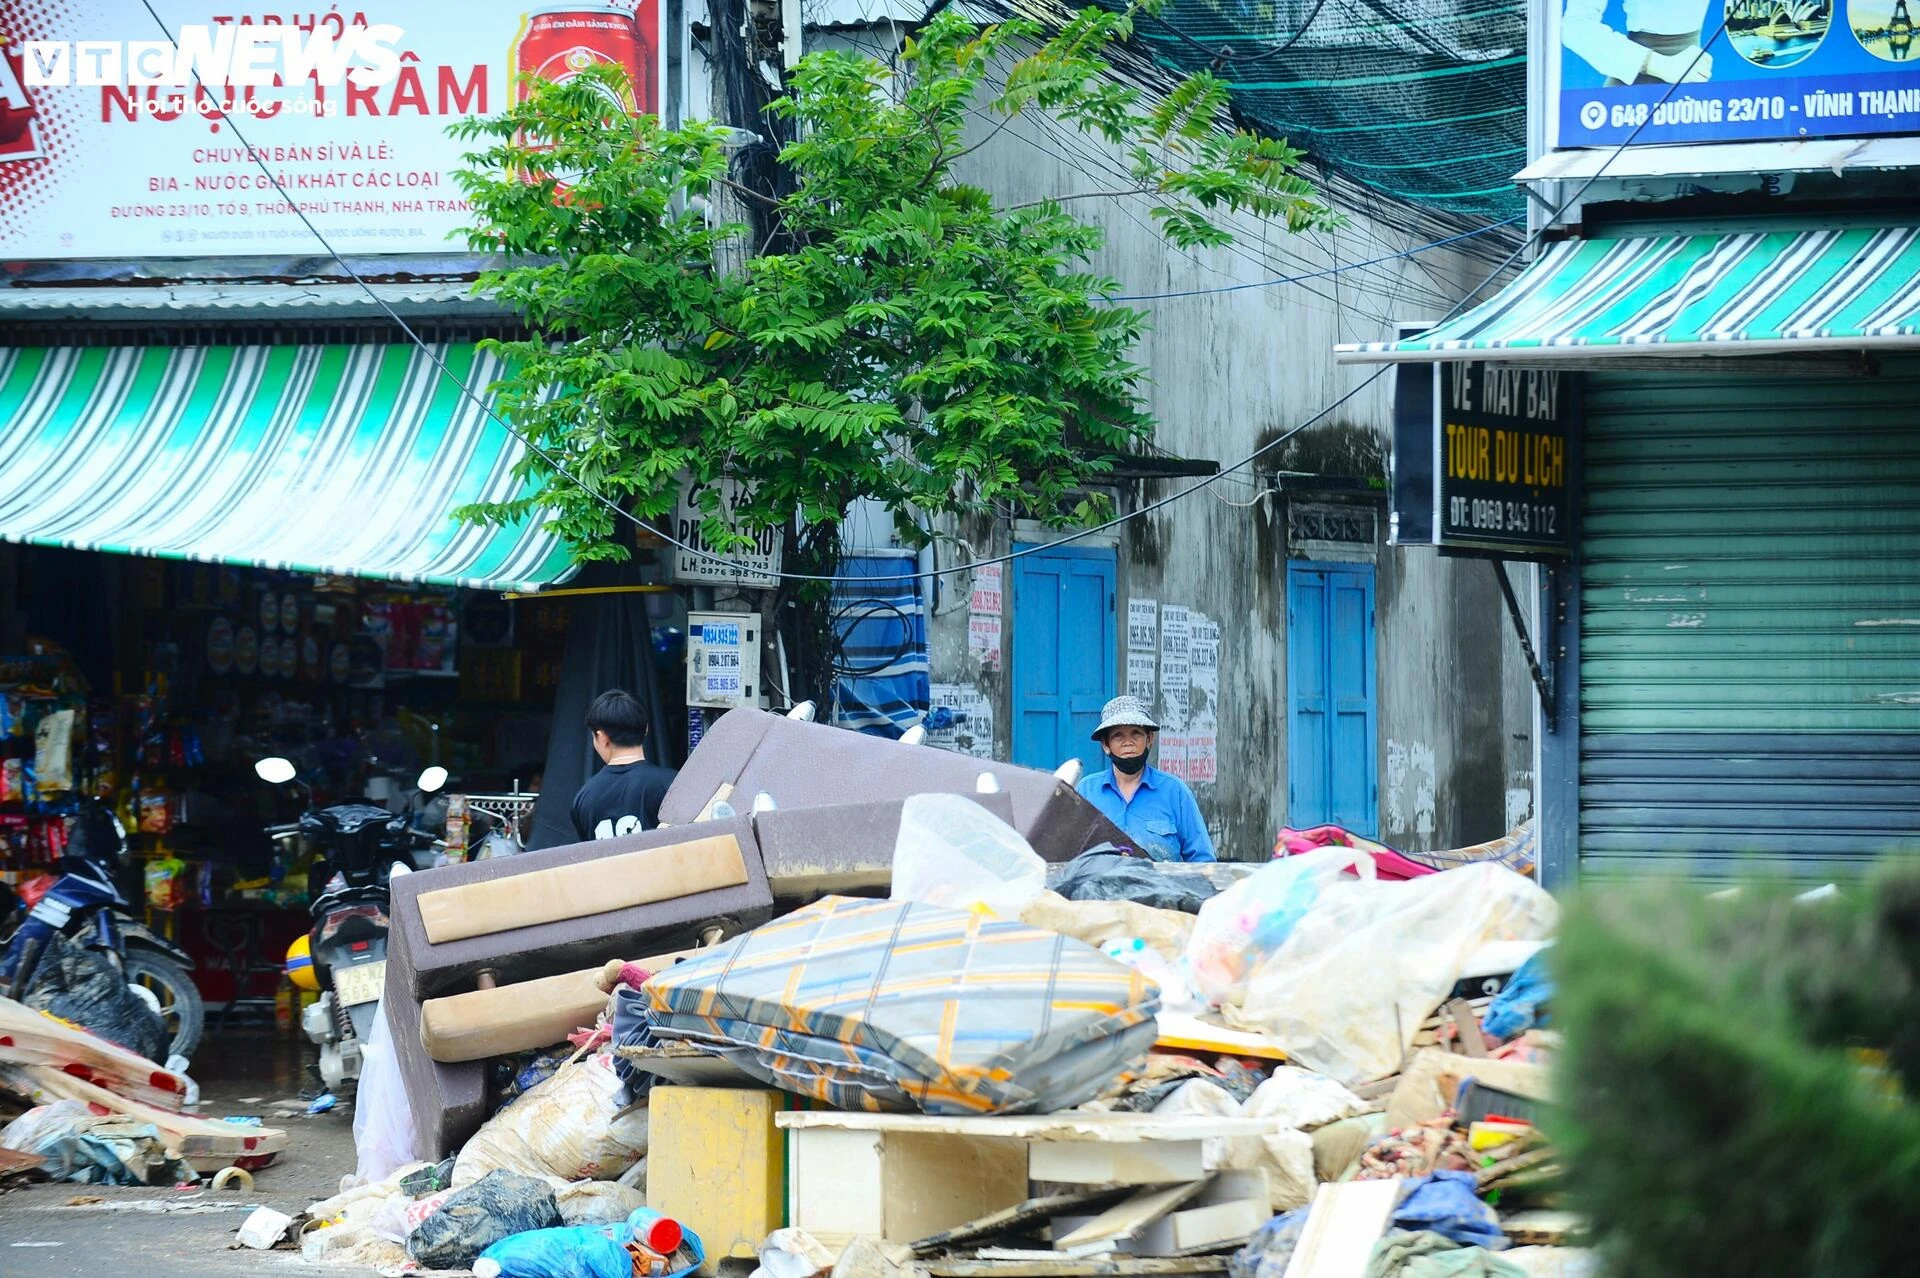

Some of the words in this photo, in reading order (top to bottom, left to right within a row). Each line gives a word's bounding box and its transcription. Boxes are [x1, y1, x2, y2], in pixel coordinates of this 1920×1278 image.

[1611, 103, 1649, 128] 648
[1653, 95, 1723, 126] ĐƯỜNG
[1727, 96, 1785, 122] 23/10
[1804, 89, 1853, 118] VĨNH
[193, 144, 270, 163] CHUYÊN
[275, 142, 313, 162] BÁN
[317, 141, 334, 161] SỈ
[338, 141, 363, 160] VÀ
[367, 139, 394, 160] LẺ:
[149, 177, 179, 192] BIA
[195, 171, 251, 191] NƯỚC
[256, 170, 293, 190] GIẢI
[298, 168, 348, 189] KHÁT
[352, 168, 391, 187] CÁC
[396, 171, 439, 191] LOẠI
[111, 202, 165, 218] ĐƯỜNG
[256, 200, 297, 215] THÔN
[300, 199, 329, 214] PHÚ
[392, 201, 424, 213] NHA
[1526, 368, 1560, 421] BAY
[1446, 424, 1490, 481] TOUR
[1496, 430, 1519, 484] DU
[1524, 433, 1564, 497] LỊCH
[1472, 498, 1503, 530] 0969
[1506, 501, 1530, 532] 343
[1533, 504, 1556, 534] 112
[701, 567, 727, 576] 0976
[752, 561, 769, 570] 743
